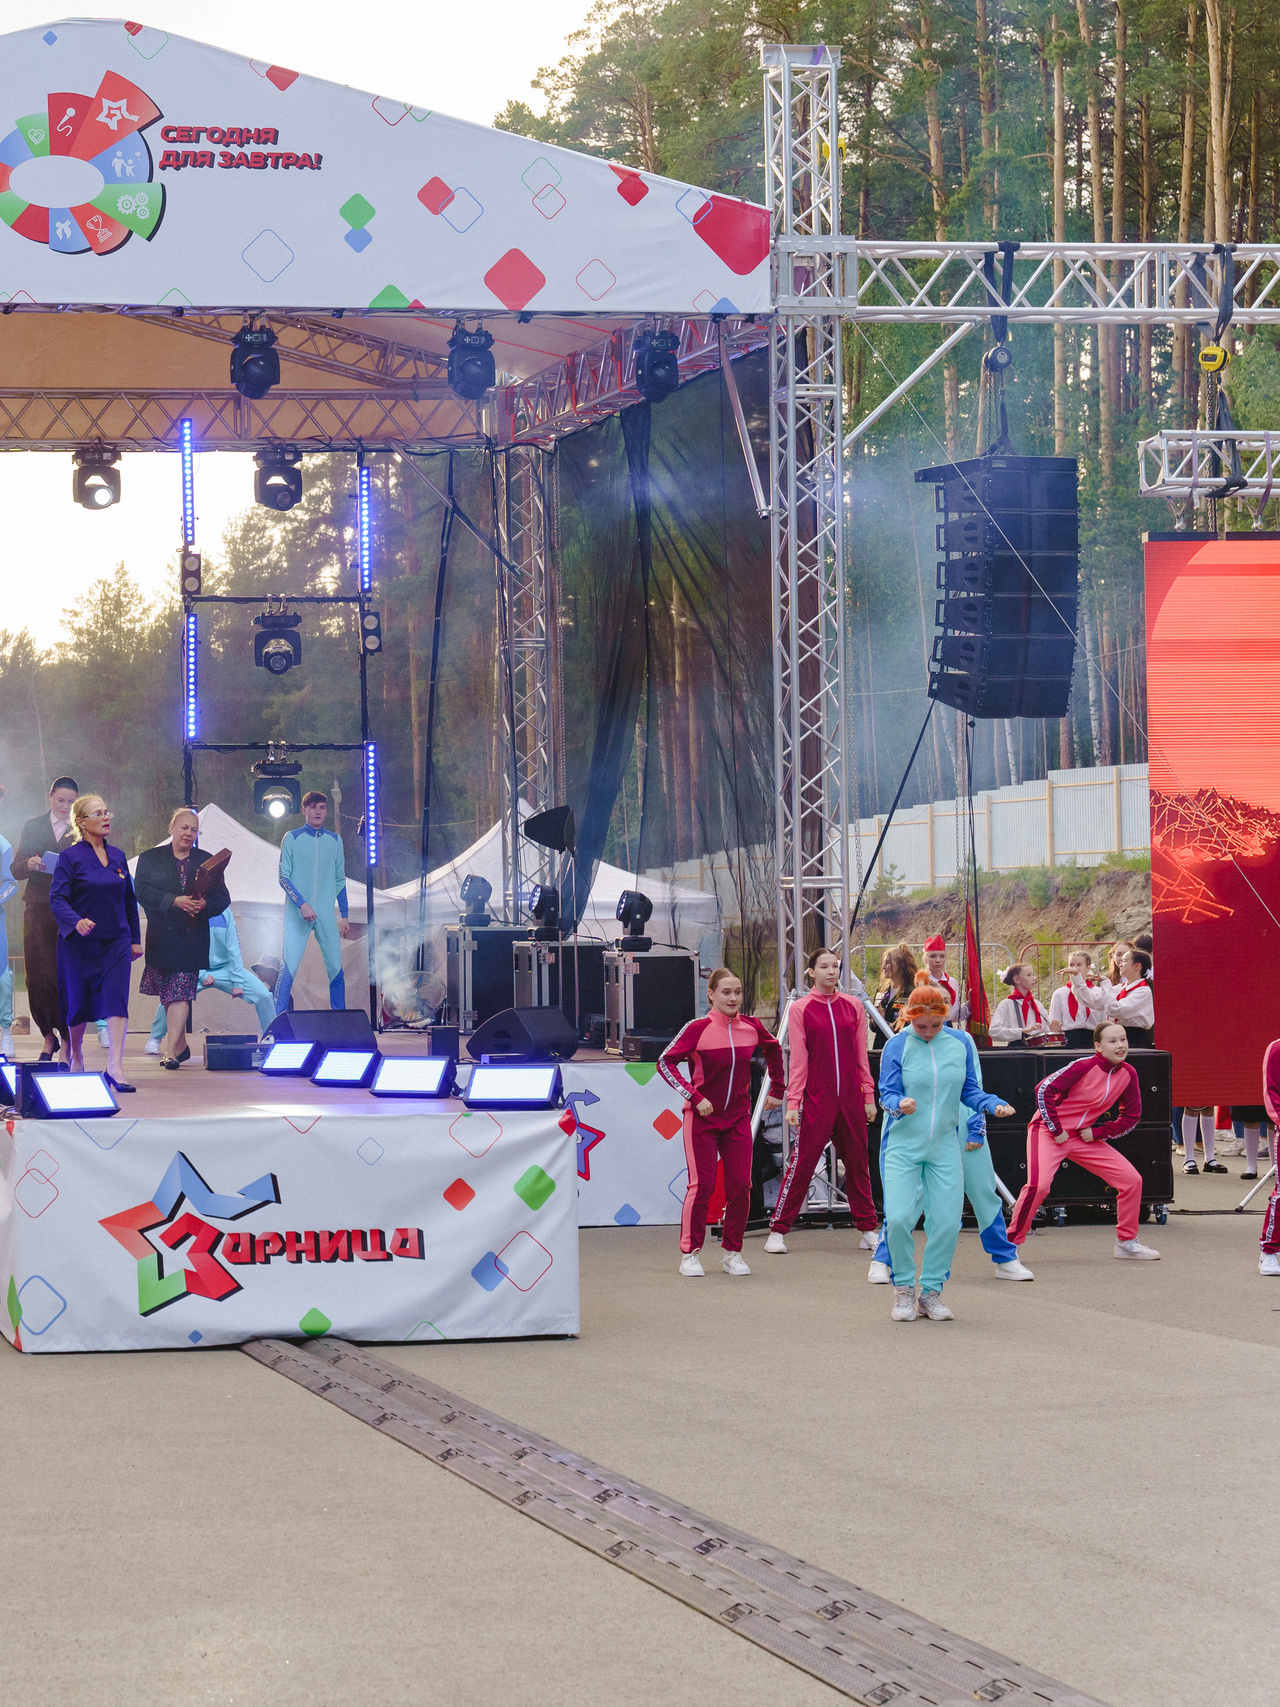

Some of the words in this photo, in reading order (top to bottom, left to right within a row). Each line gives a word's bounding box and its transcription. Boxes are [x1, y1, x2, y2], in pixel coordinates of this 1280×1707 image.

[159, 125, 280, 146] СЕГОДНЯ
[158, 150, 215, 170] ДЛЯ
[217, 150, 323, 171] ЗАВТРА!
